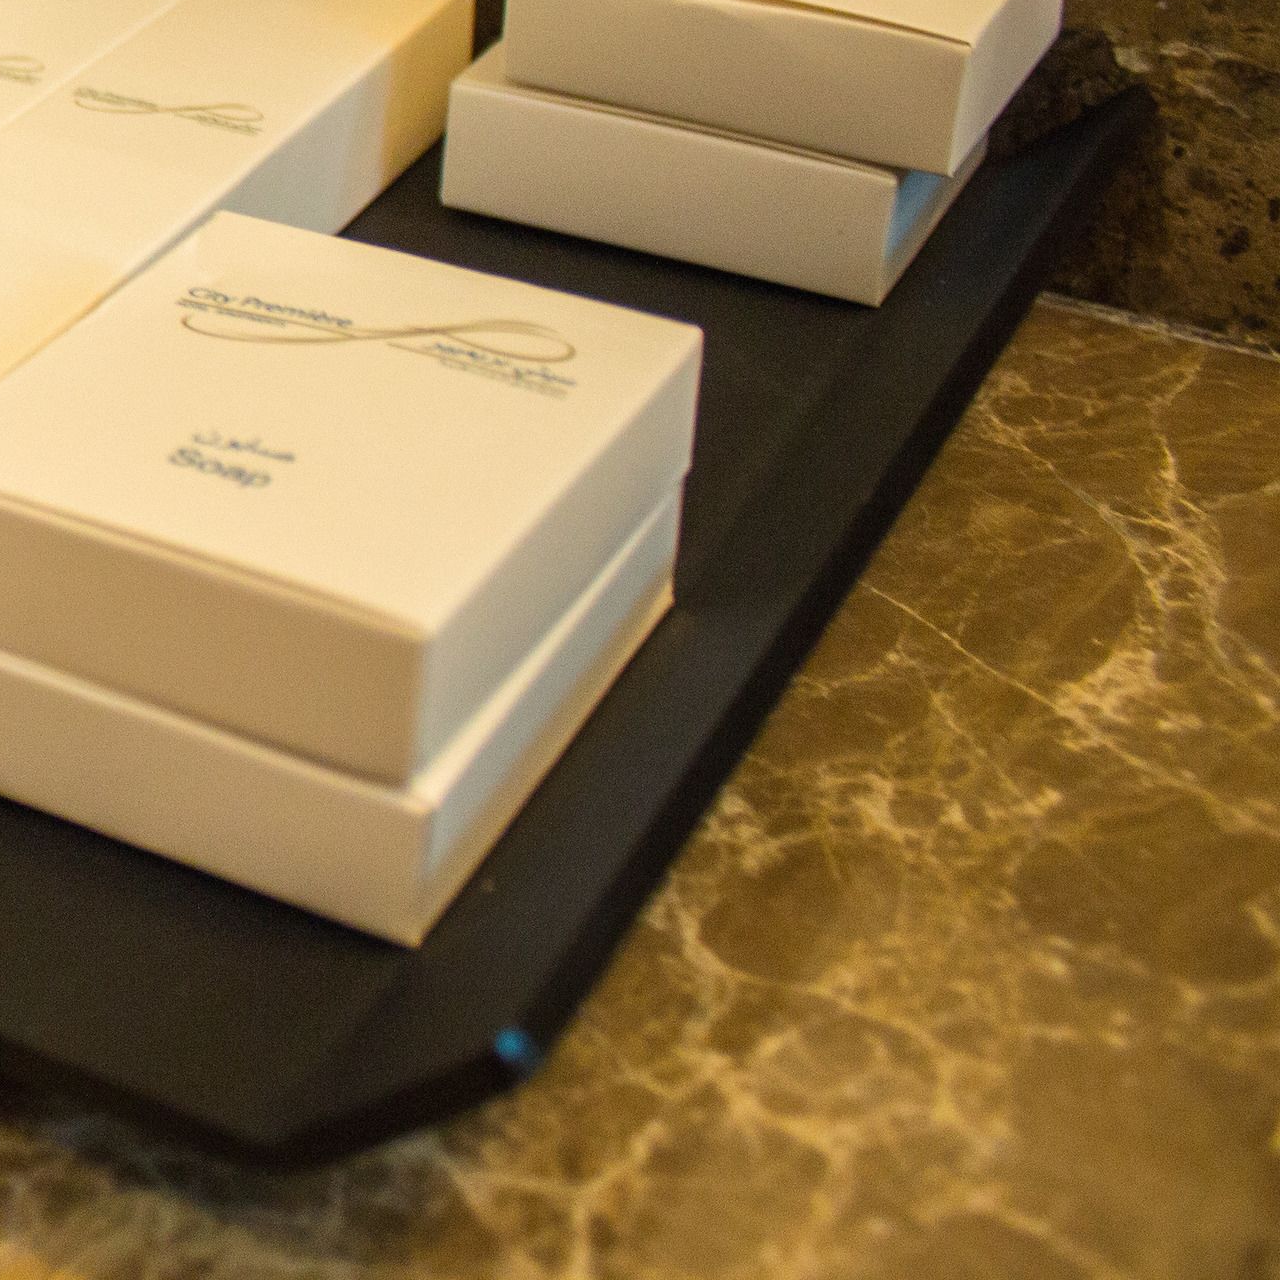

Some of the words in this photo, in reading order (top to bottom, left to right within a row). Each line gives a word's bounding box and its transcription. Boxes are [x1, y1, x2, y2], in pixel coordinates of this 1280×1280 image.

[188, 287, 237, 304] City
[241, 296, 353, 328] Première
[168, 448, 272, 488] Soap
